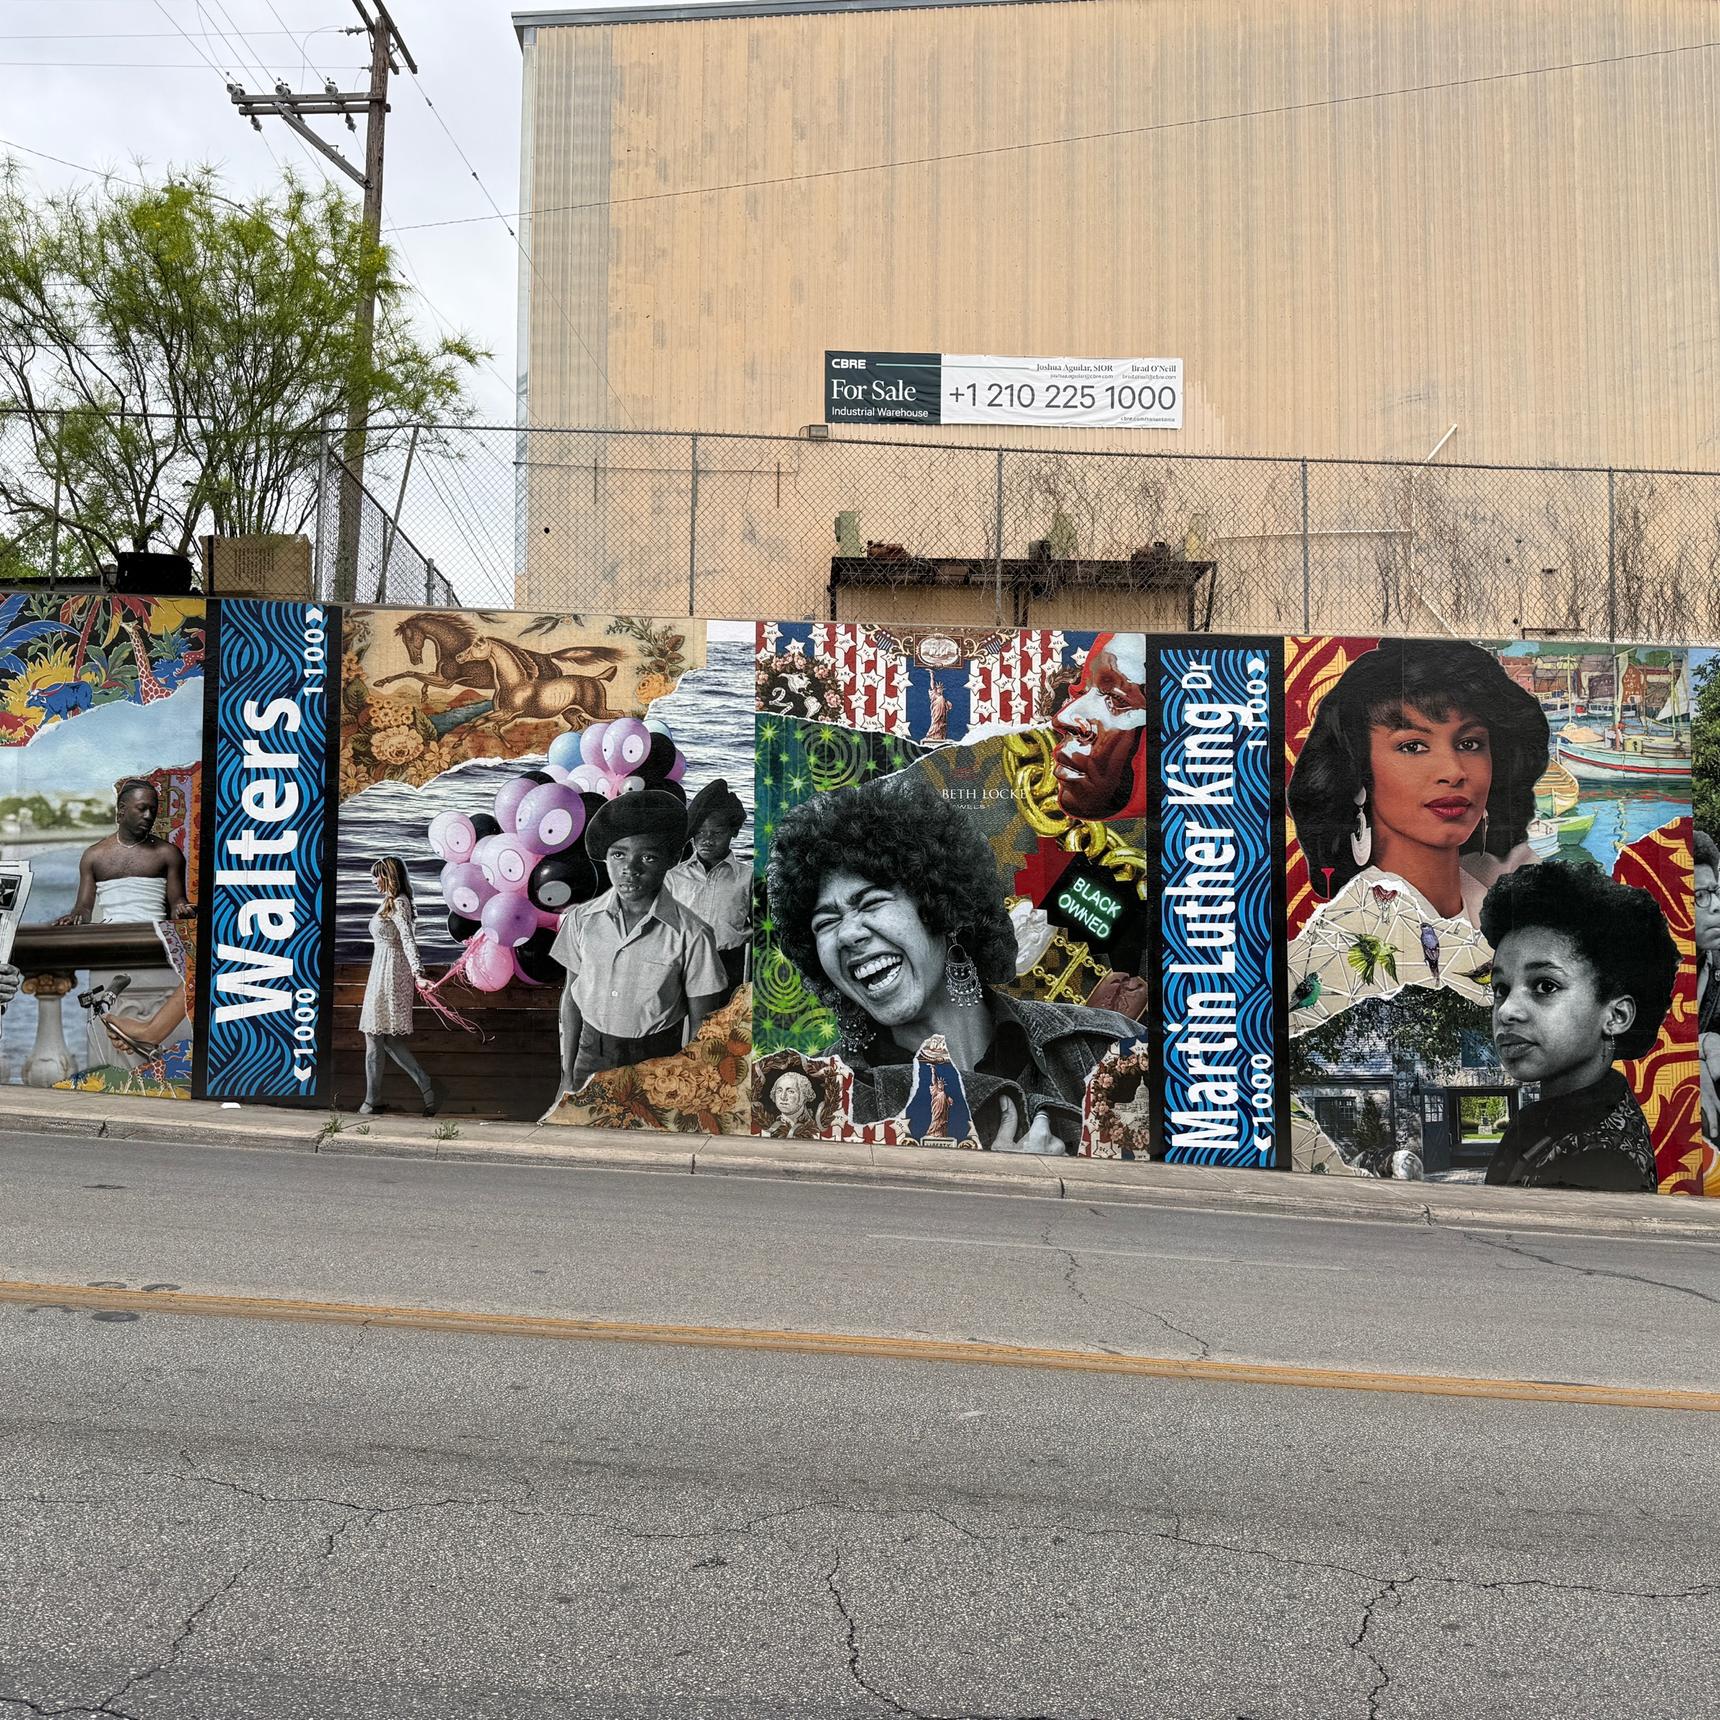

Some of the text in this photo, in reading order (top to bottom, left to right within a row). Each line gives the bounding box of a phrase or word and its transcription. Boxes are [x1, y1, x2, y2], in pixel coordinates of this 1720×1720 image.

[832, 359, 867, 369] CBRE
[1036, 363, 1113, 373] Joshua Aguilar, SIOR
[1131, 364, 1177, 373] Brad O'Neill
[831, 379, 917, 401] For Sale
[949, 383, 1176, 410] +1 210 225 1000
[831, 406, 929, 418] Industrial Warehouse
[303, 628, 325, 696] 1100
[1246, 679, 1268, 750] 1100
[942, 788, 976, 800] BETH
[215, 697, 301, 1024] Walters
[1058, 893, 1110, 938] OWNED
[1073, 877, 1122, 919] BLACK
[1164, 661, 1251, 1150] Martin Luther King Dr
[293, 988, 316, 1059] 1000
[1250, 1053, 1273, 1127] 1000
